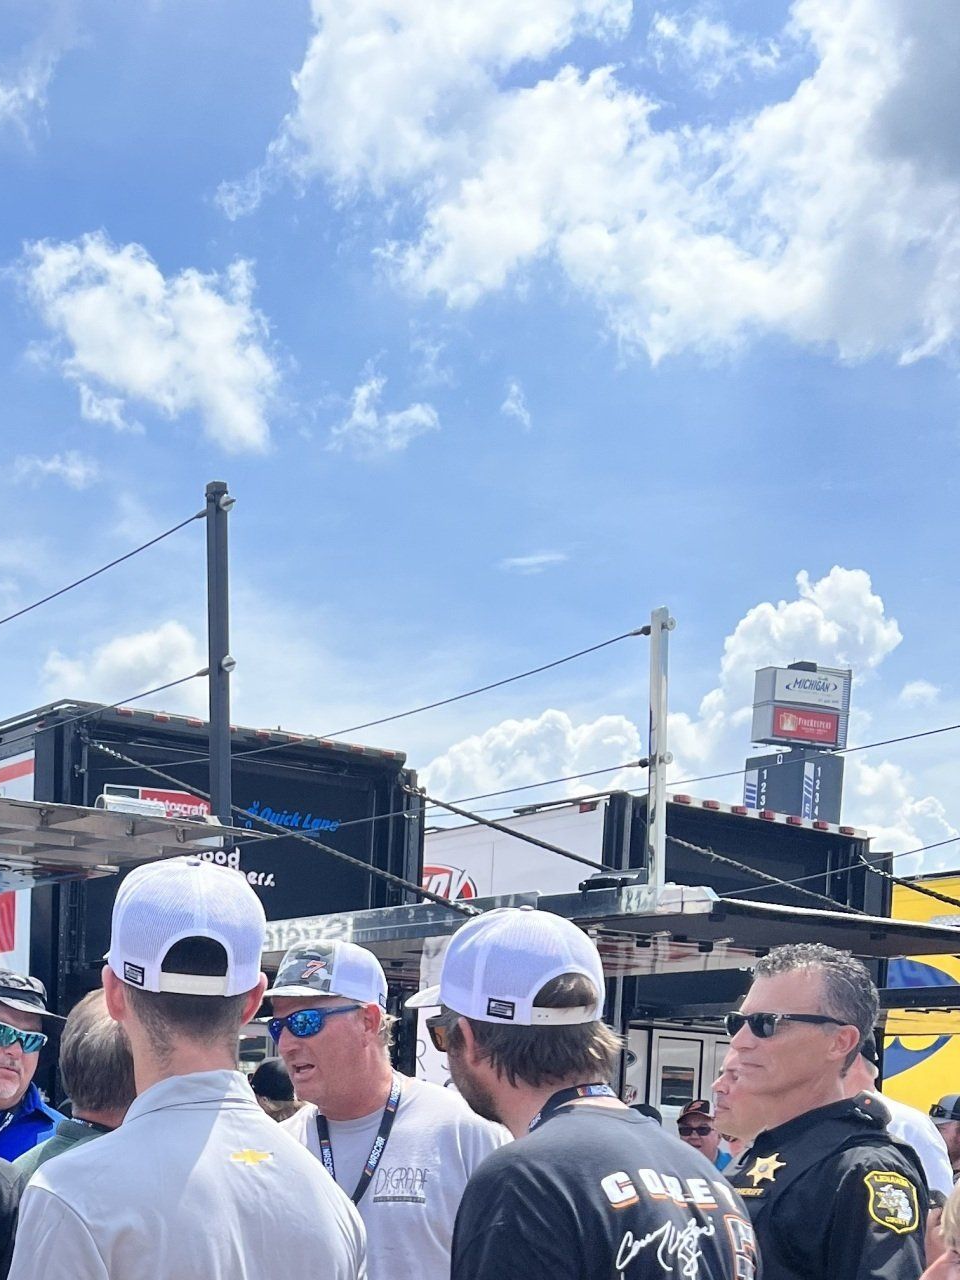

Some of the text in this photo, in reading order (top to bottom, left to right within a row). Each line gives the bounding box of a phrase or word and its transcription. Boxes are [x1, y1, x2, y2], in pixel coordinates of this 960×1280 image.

[793, 678, 830, 692] MICHIGAN
[761, 782, 767, 793] 2
[815, 780, 820, 790] 2
[258, 806, 340, 833] Quick Lane
[301, 960, 327, 979] 7
[368, 1136, 386, 1167] NASCAR
[736, 1187, 765, 1196] HERIFF
